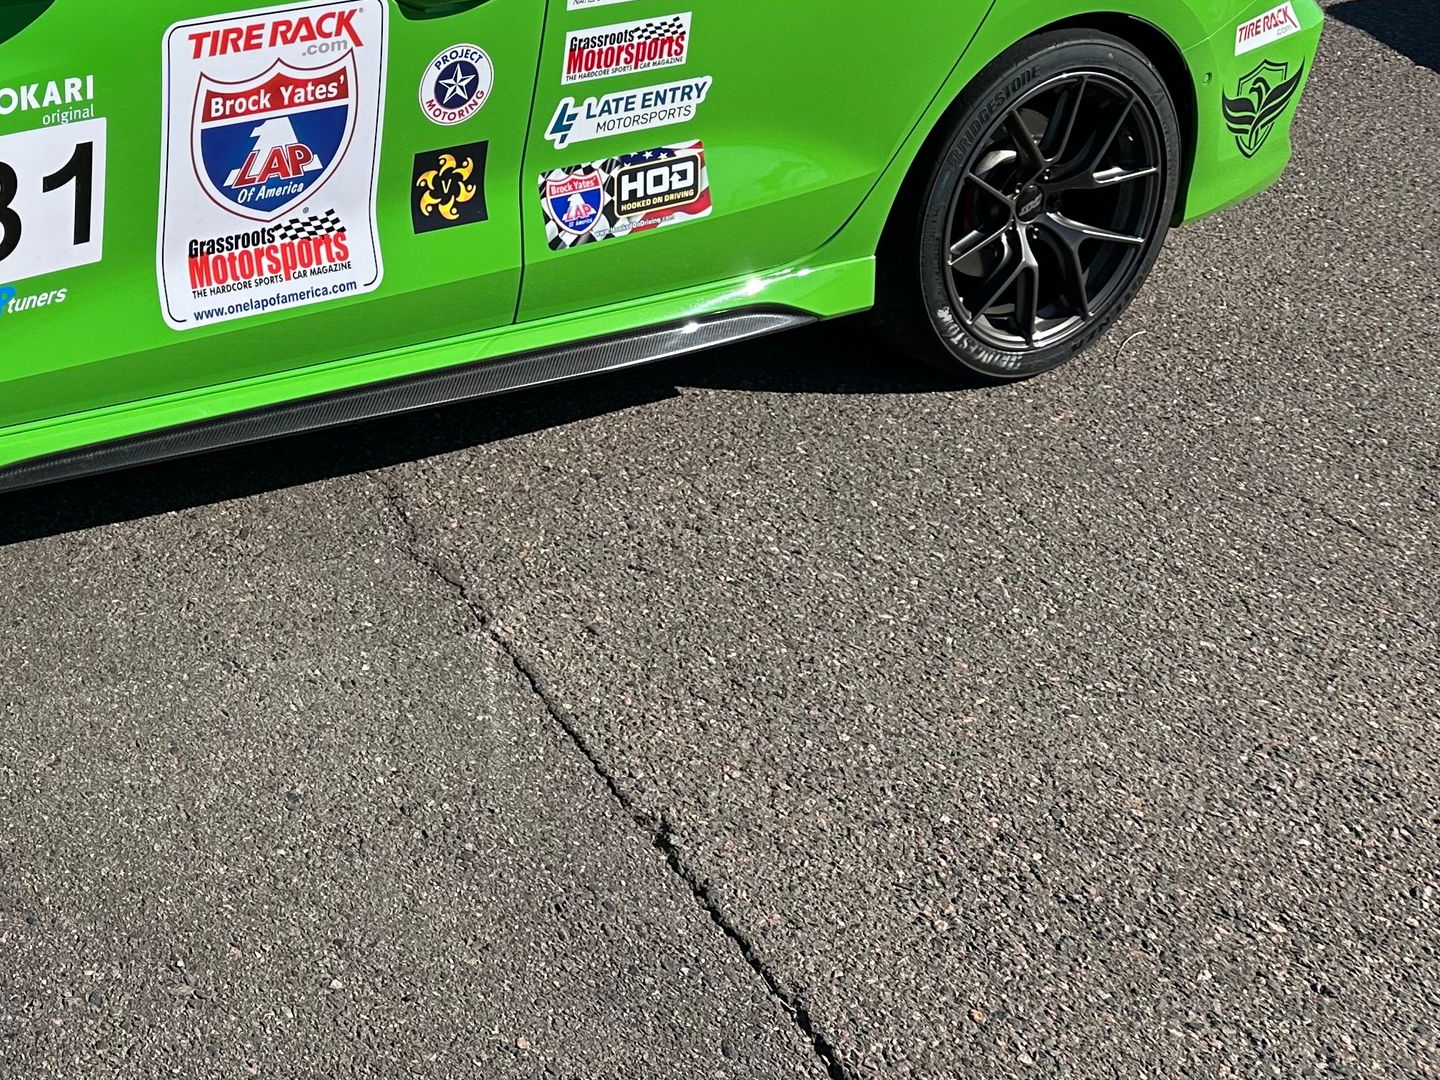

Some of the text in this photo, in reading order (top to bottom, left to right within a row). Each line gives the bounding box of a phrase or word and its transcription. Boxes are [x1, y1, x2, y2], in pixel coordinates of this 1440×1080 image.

[188, 8, 364, 60] TIRE RACK
[1238, 5, 1297, 43] TIRE RACK
[301, 39, 348, 56] .com
[566, 33, 686, 75] Motorsports
[570, 29, 635, 52] Grassroots
[434, 48, 483, 71] PROJECT
[566, 56, 683, 82] THE HARDCORE SPORTS CAR MAGAZINE
[211, 74, 344, 118] Brock Yates'
[425, 89, 485, 121] MOTORING
[585, 81, 707, 119] LATE ENTRY
[42, 103, 94, 126] original
[596, 105, 691, 133] MOTORSPORTS
[946, 65, 1041, 167] BRIDGESTONE
[231, 143, 314, 189] LAP
[621, 161, 694, 201] HOD
[237, 181, 304, 204] Of America
[441, 178, 452, 194] V
[550, 175, 596, 196] Brock Yates'
[621, 189, 694, 211] HOOKED ON DRIVING
[564, 204, 592, 222] LAP
[188, 227, 275, 259] Grassroots
[188, 231, 349, 290] Motorsports
[192, 261, 352, 299] THE HARDCORE SPORTS CAR MAGAZINE
[193, 279, 357, 321] www.onelapofamerica.com
